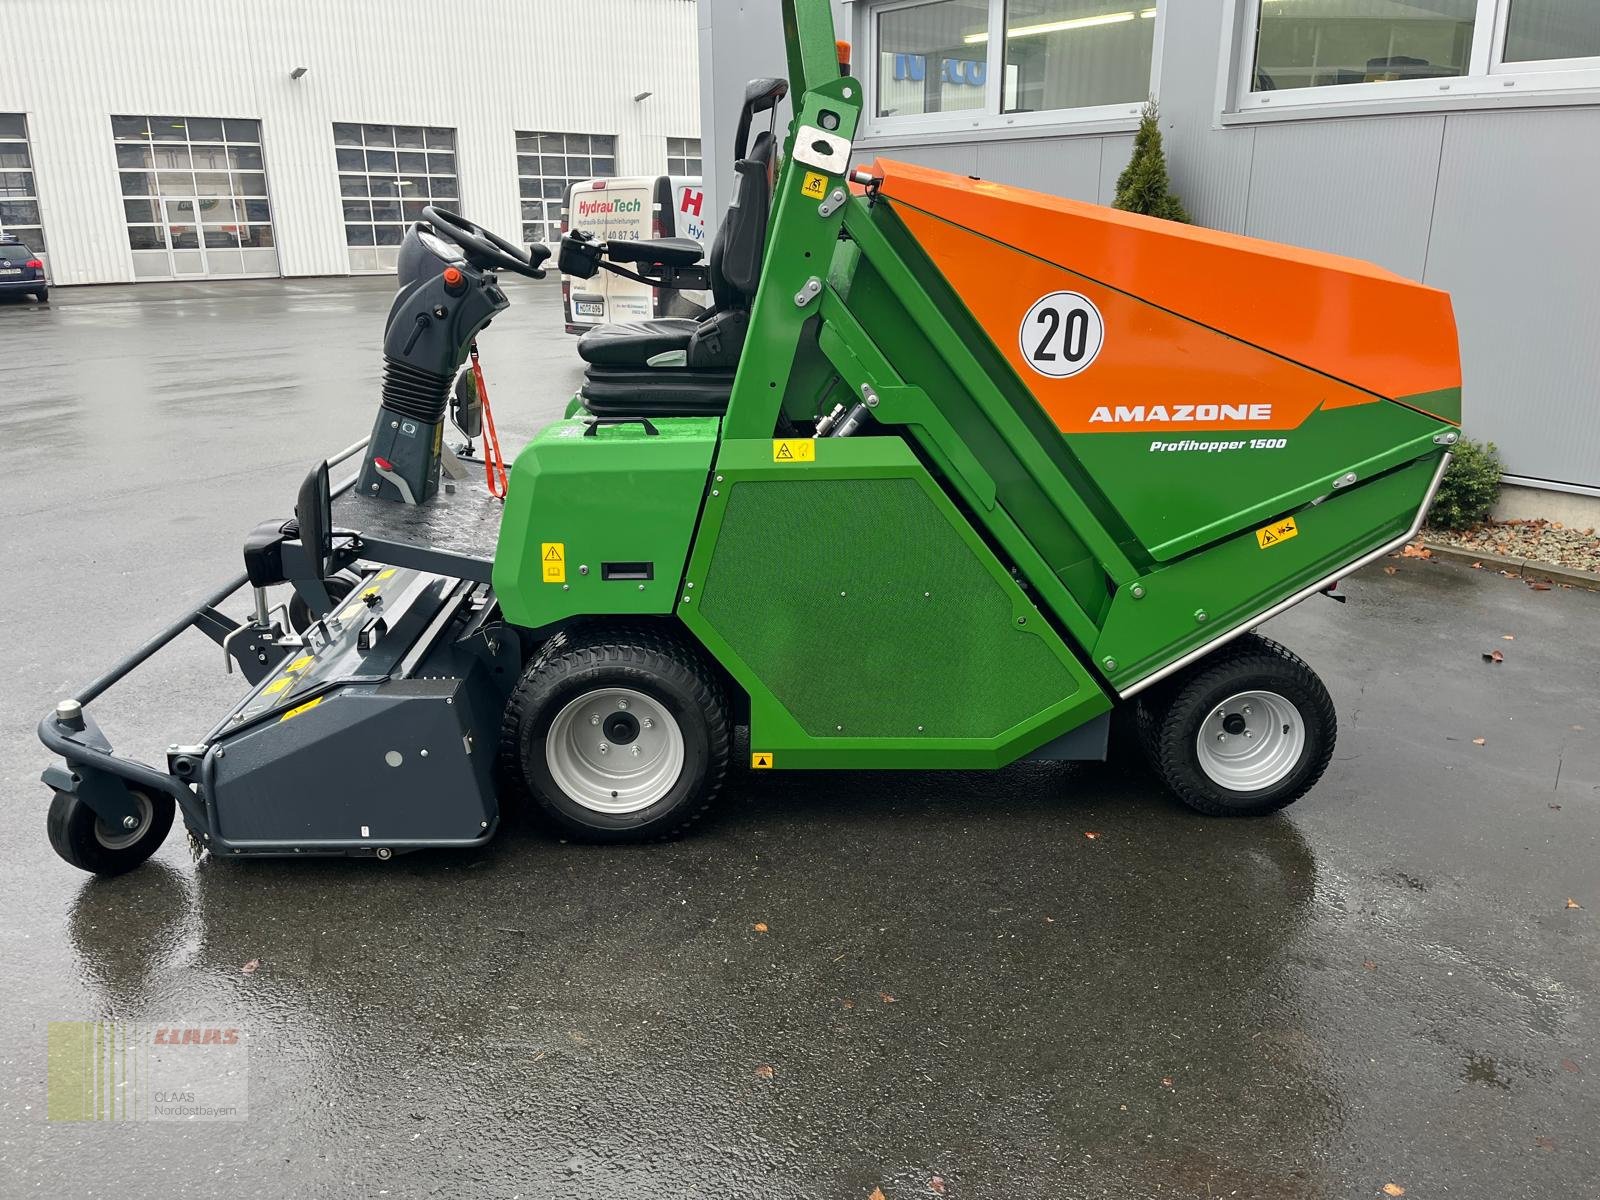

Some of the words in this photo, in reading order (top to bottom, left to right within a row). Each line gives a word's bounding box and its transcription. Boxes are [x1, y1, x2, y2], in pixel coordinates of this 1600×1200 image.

[579, 198, 641, 217] HydrauTech
[608, 230, 617, 239] 40
[618, 230, 627, 240] 87
[629, 230, 639, 240] 34
[1033, 307, 1089, 362] 20
[1088, 404, 1272, 423] AMAZONE
[1150, 440, 1246, 453] Profihopper
[1249, 438, 1287, 449] 1500
